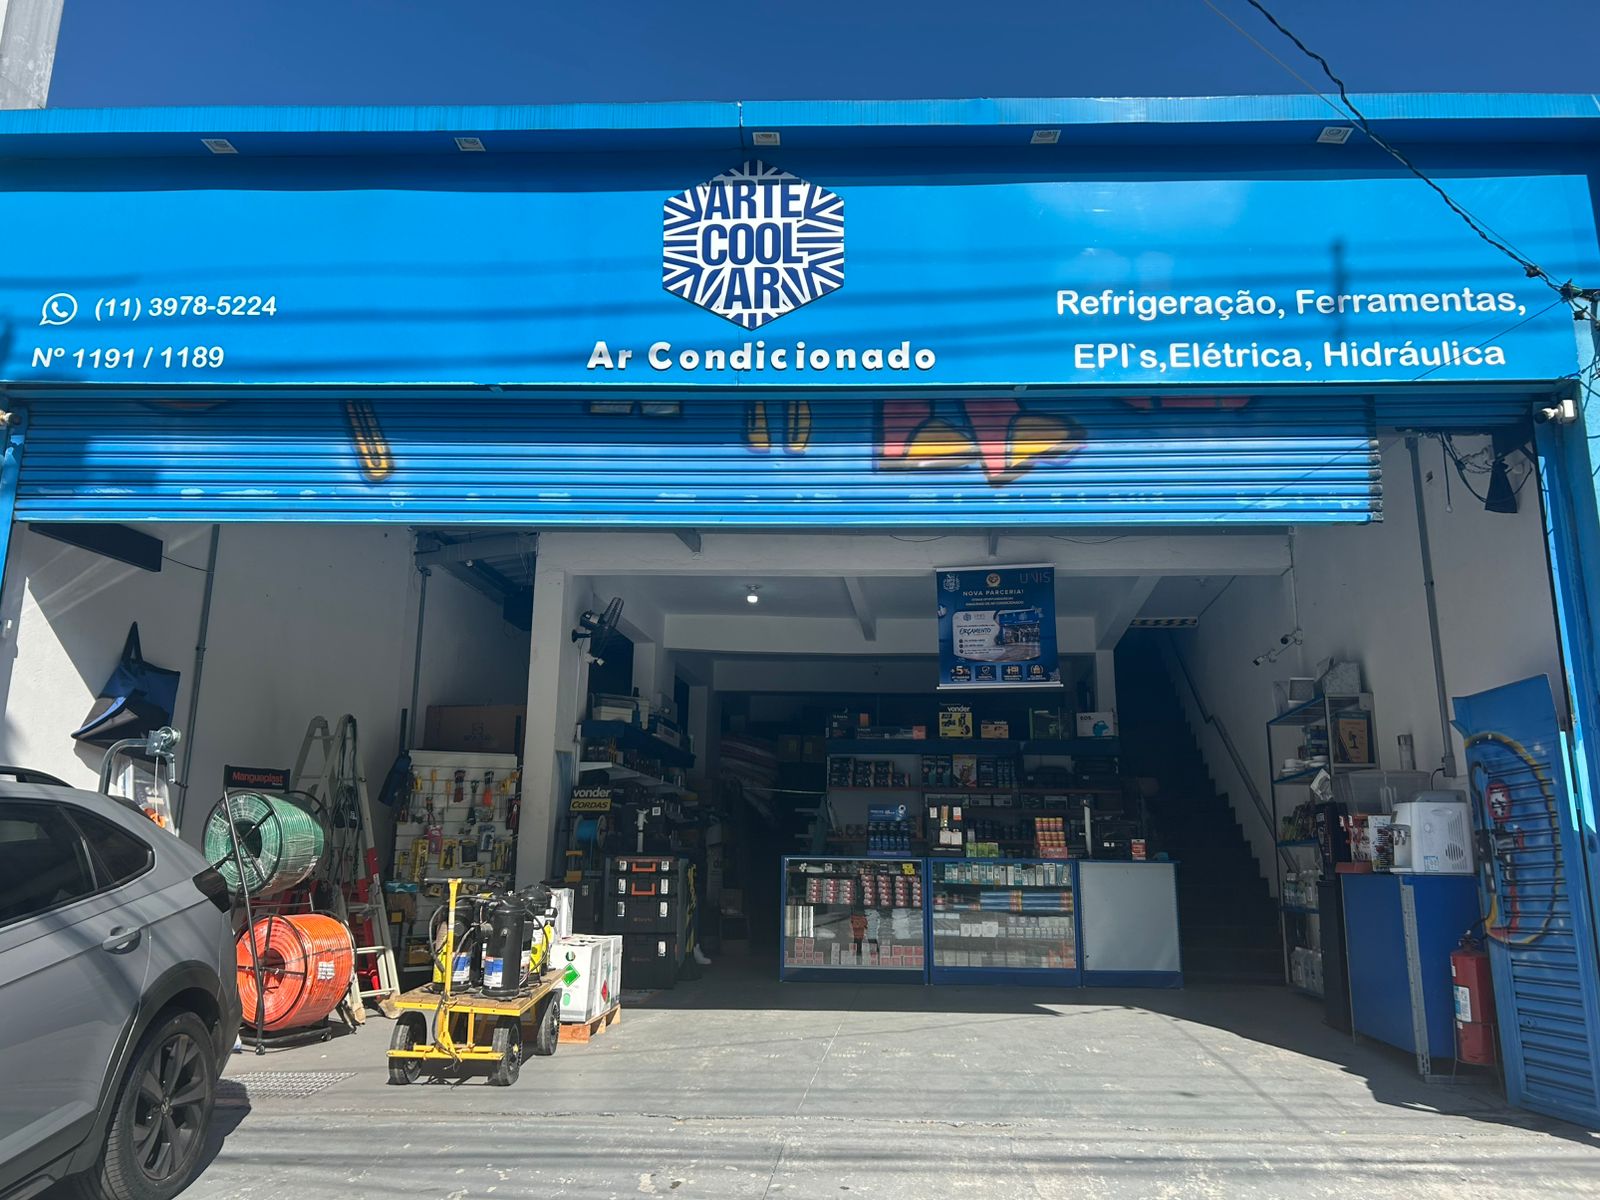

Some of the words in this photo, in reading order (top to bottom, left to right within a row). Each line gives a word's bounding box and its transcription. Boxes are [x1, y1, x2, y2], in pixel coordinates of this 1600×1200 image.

[703, 178, 803, 220] ARTE
[701, 222, 804, 266] COOL
[723, 266, 780, 310] AR
[95, 298, 142, 321] (11)
[148, 296, 277, 317] 3978-5224
[1056, 289, 1286, 321] Refrigeração,
[1295, 287, 1527, 316] Ferramentas,
[31, 347, 65, 368] Nº
[72, 348, 135, 369] 1191
[143, 346, 154, 369] /
[160, 346, 225, 369] 1189
[586, 340, 633, 370] Ar
[648, 340, 937, 372] Condicionado
[1323, 340, 1506, 367] Hidráulica
[947, 704, 972, 713] vonder
[571, 800, 609, 809] CORDAS
[573, 786, 612, 798] vonder
